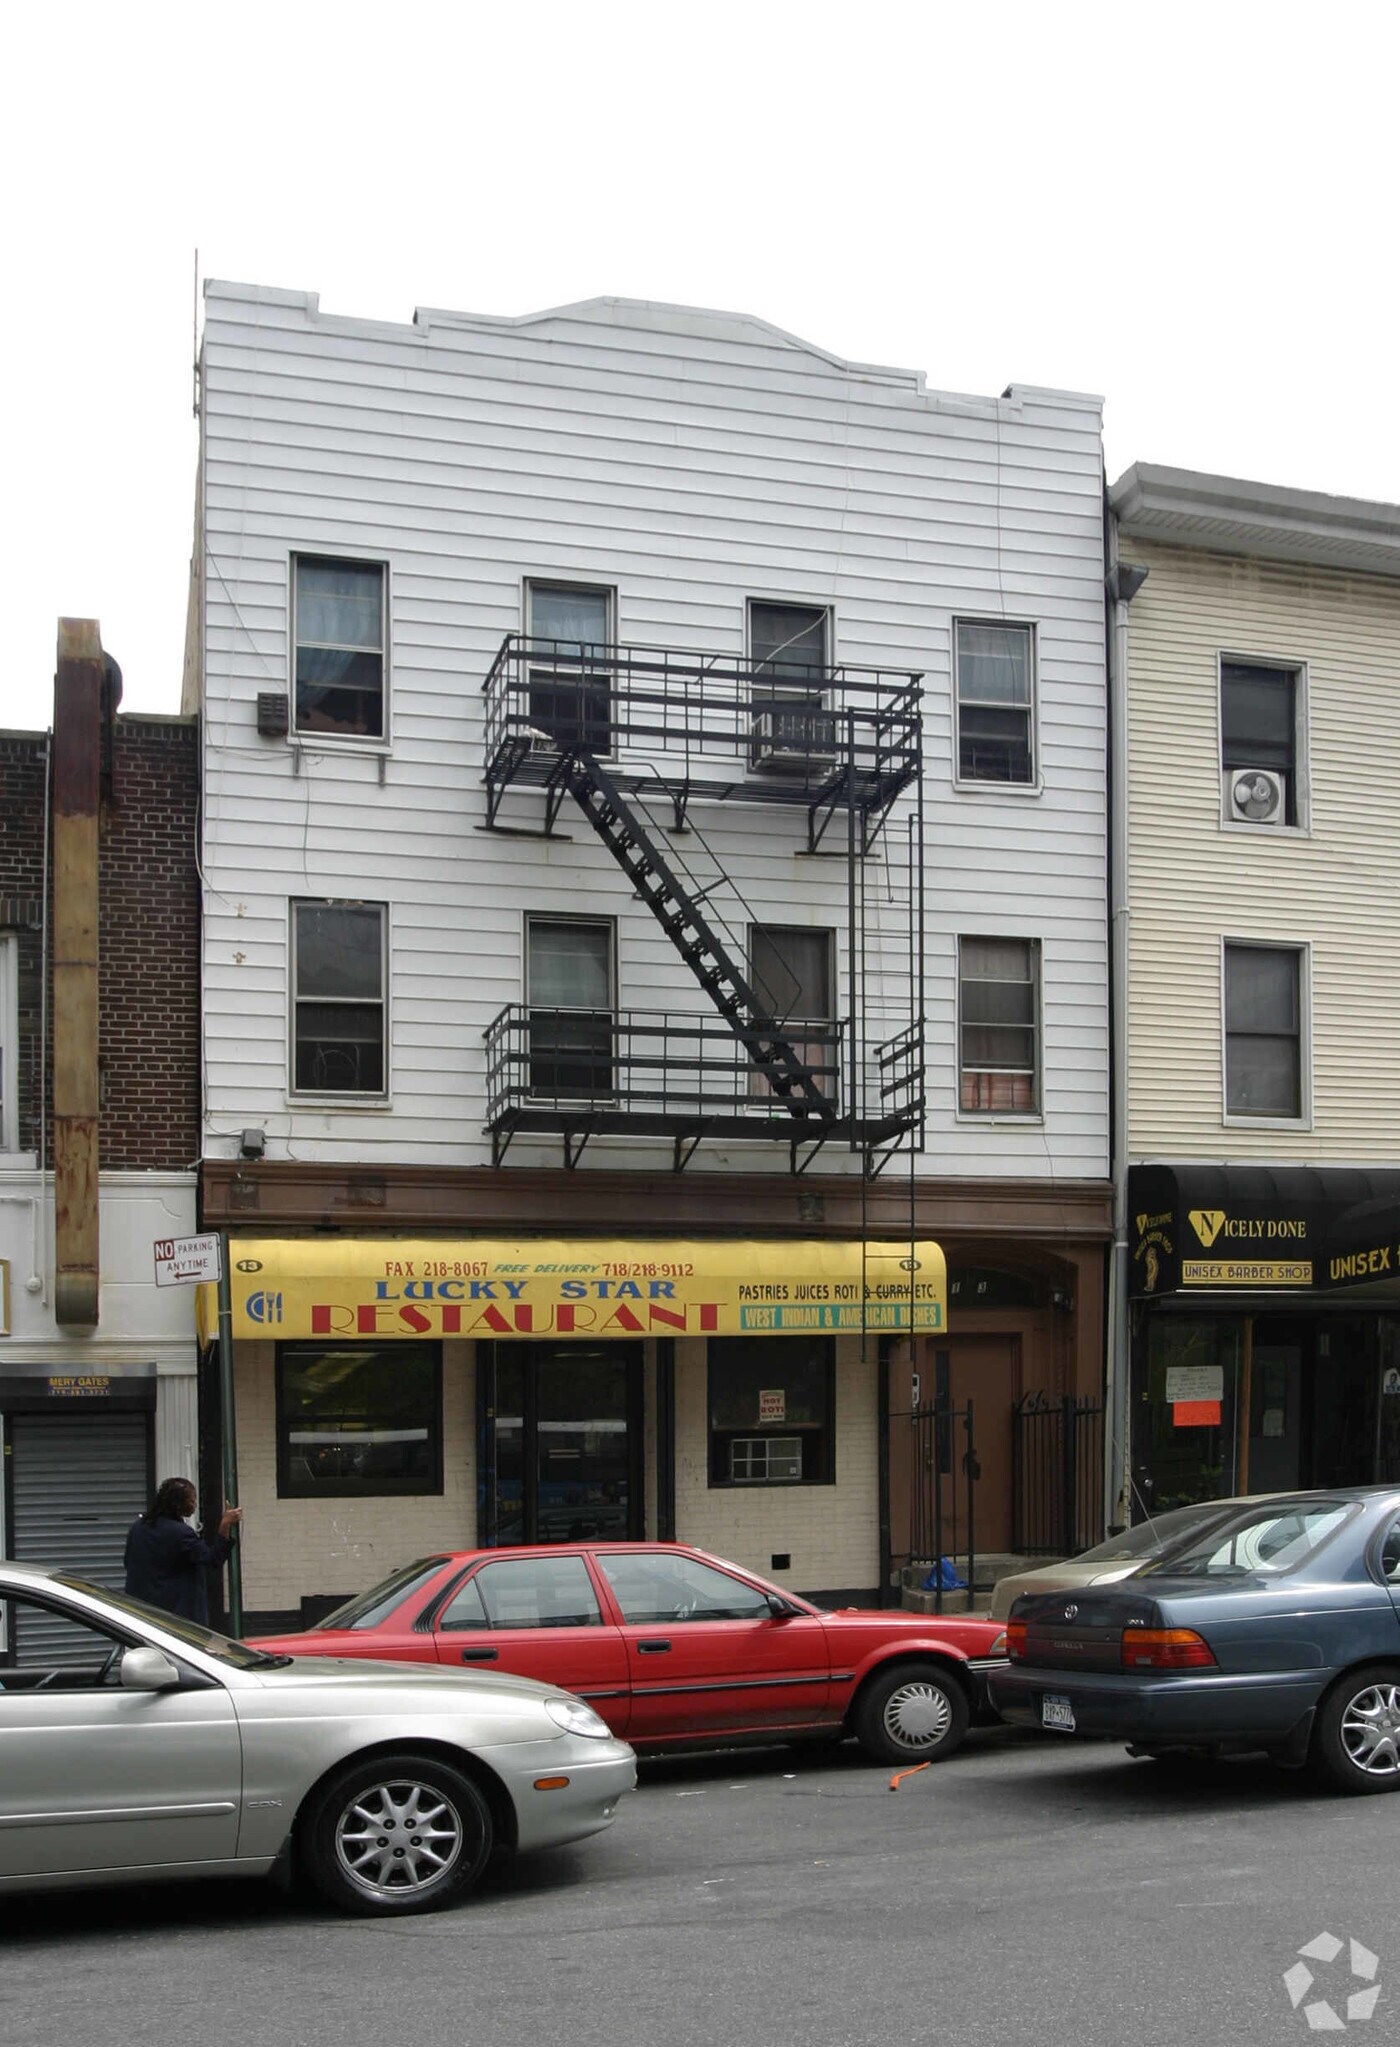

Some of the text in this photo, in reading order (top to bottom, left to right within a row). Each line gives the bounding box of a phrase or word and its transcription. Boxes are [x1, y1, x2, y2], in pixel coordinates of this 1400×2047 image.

[1200, 1212, 1306, 1238] NICELY DONE
[155, 1241, 213, 1260] NO PARKING
[167, 1258, 209, 1271] ANYTIME
[385, 1261, 488, 1277] FAX 218-8067
[493, 1263, 600, 1273] FREE DELIVERY
[602, 1263, 694, 1277] 718/218-9112
[1330, 1247, 1390, 1280] UNISEX
[1185, 1265, 1311, 1279] UNISEX BARBER SHOP
[375, 1280, 676, 1299] LUCKY STAR
[739, 1284, 788, 1300] PASTRIES
[794, 1284, 829, 1300] JUICES
[835, 1284, 858, 1299] ROTI
[876, 1284, 911, 1299] CURRY
[915, 1284, 936, 1298] ETC.
[312, 1302, 728, 1334] RESTAURANT
[745, 1307, 776, 1328] WEST
[781, 1307, 819, 1328] INDIAN
[825, 1307, 832, 1328] &
[78, 1377, 110, 1386] GATES
